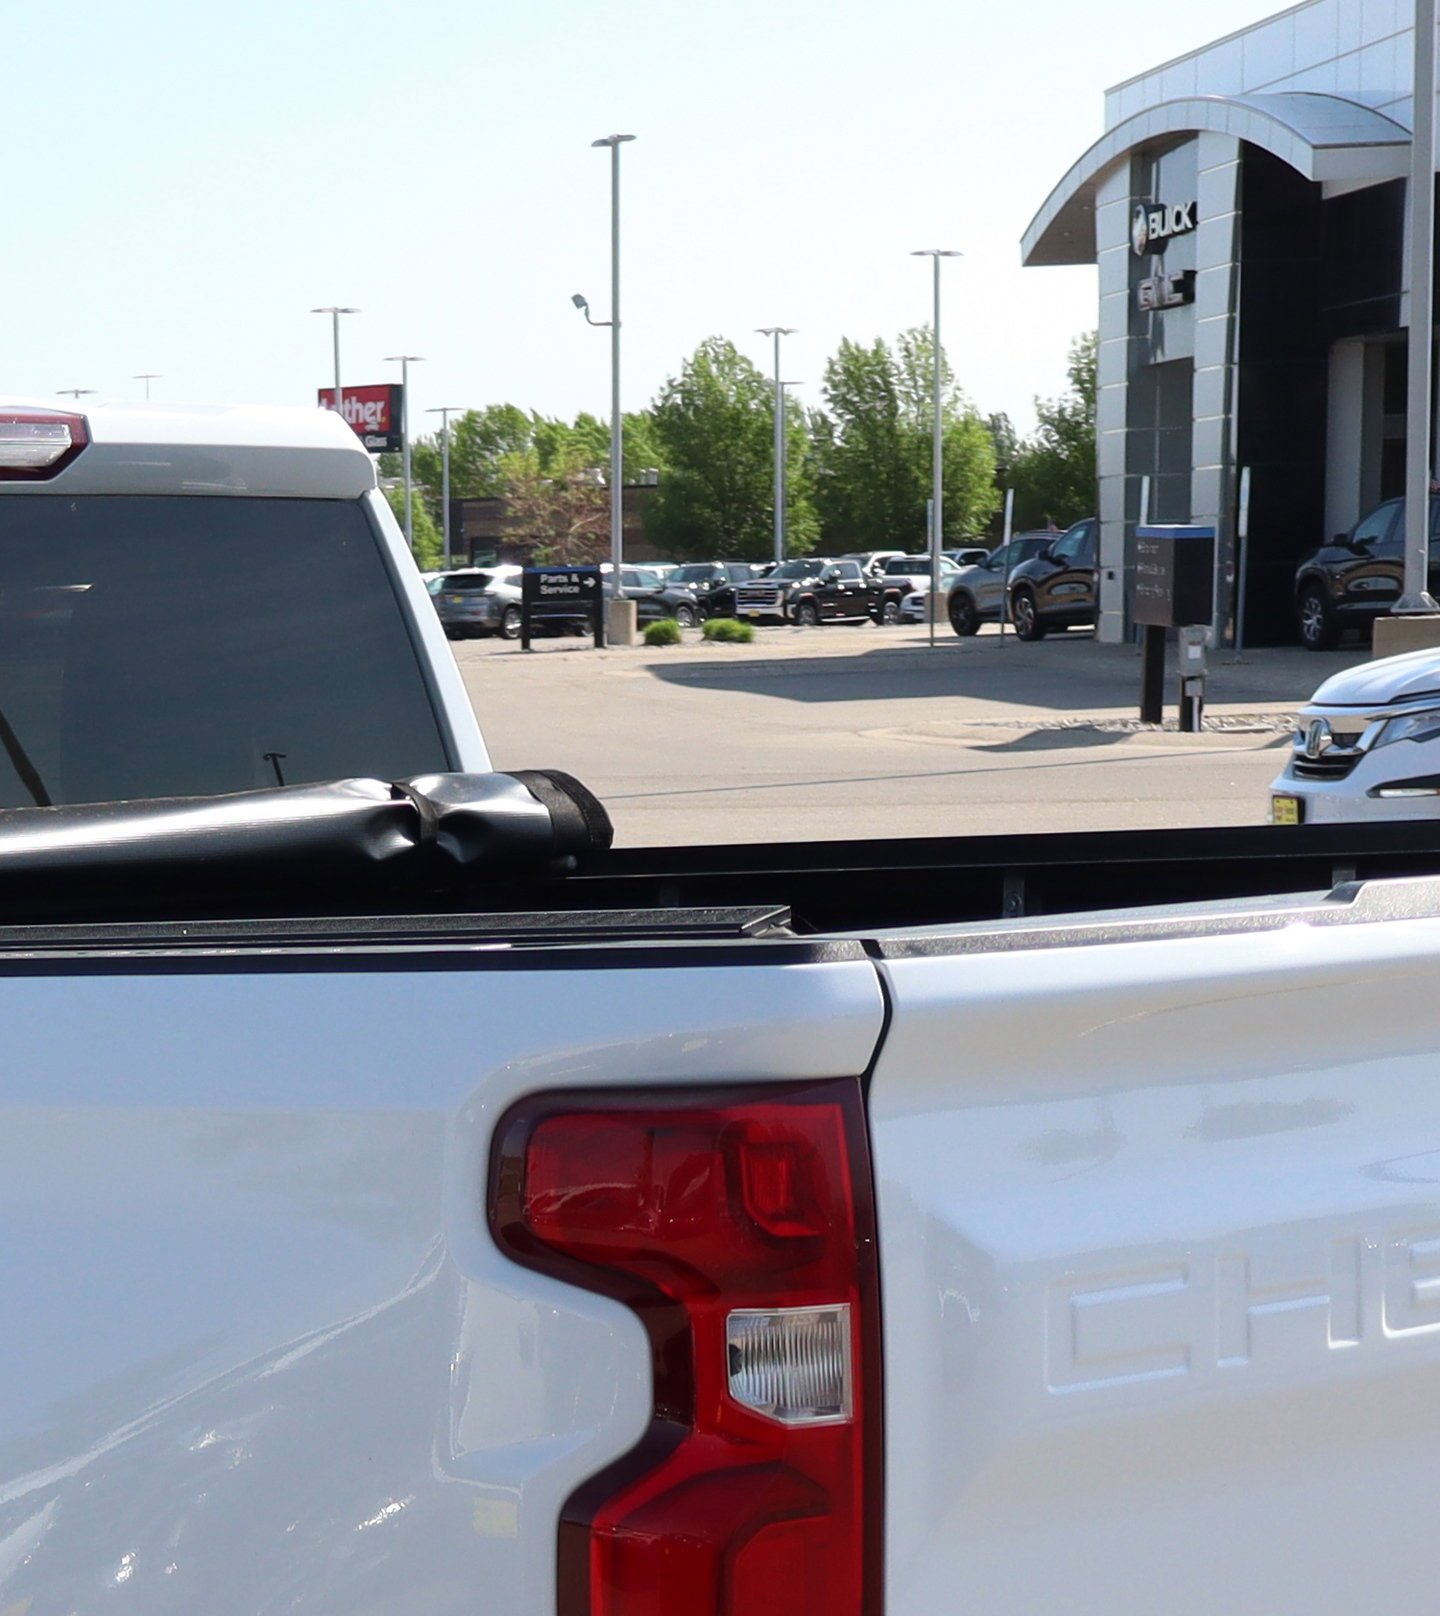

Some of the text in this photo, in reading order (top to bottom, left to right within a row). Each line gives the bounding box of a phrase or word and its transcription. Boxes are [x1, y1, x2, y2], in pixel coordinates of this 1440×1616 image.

[1148, 200, 1193, 240] BUICK
[540, 573, 579, 583] Parts &
[540, 585, 579, 595] Service
